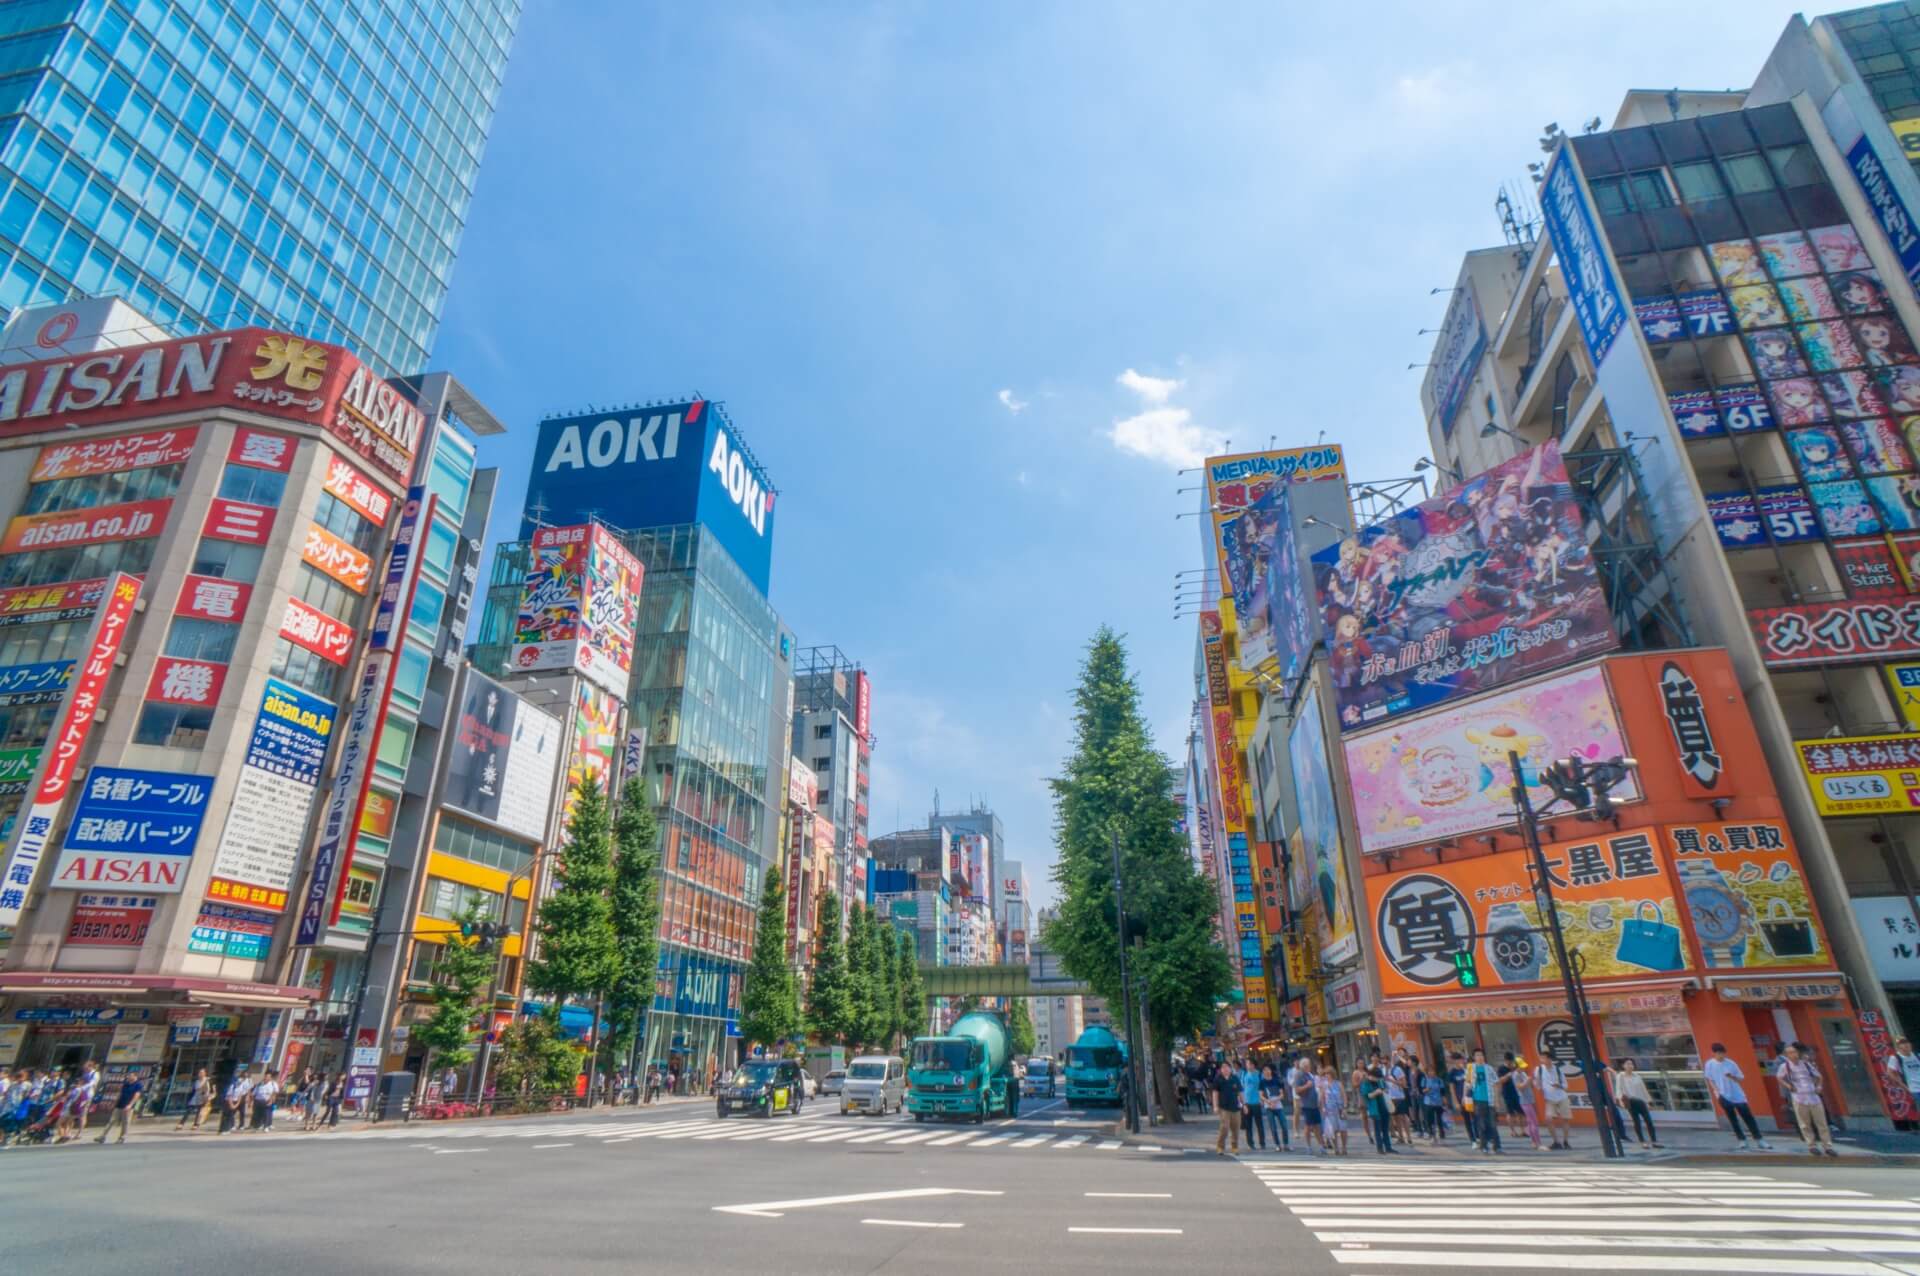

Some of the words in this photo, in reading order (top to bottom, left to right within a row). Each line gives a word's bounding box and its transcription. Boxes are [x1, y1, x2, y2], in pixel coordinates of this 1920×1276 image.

[1689, 311, 1731, 335] 7F
[0, 336, 232, 421] AISAN
[250, 336, 328, 391] 光
[233, 382, 324, 411] ネットワーク
[342, 366, 424, 449] AISAN
[1728, 405, 1771, 430] 6F
[544, 413, 681, 472] AOKI
[709, 429, 765, 536] AOKI
[1211, 447, 1338, 482] MEDIAリサイクル
[20, 511, 154, 546] aisan.co.jp
[217, 505, 263, 538] 三
[1769, 511, 1816, 538] 5F
[304, 530, 373, 586] ネットワーク
[1851, 573, 1896, 587] Stars
[192, 581, 239, 617] 電
[280, 603, 354, 656] 配線パーツ
[44, 582, 136, 793] 光・ケーブル・ネットワーク
[162, 662, 214, 701] 機
[264, 696, 331, 735] aisan.co.jp
[90, 777, 205, 806] 各種ケーブル
[1828, 780, 1884, 796] りらくる
[75, 817, 192, 845] 配線パーツ
[1673, 826, 1785, 854] 質&買取
[0, 817, 51, 910] 愛三電機
[59, 857, 182, 885] AISAN
[1525, 834, 1660, 889] 大黒屋
[302, 849, 331, 934] AISAN
[71, 919, 148, 943] aisan.co.jp
[680, 966, 718, 1004] AOKI
